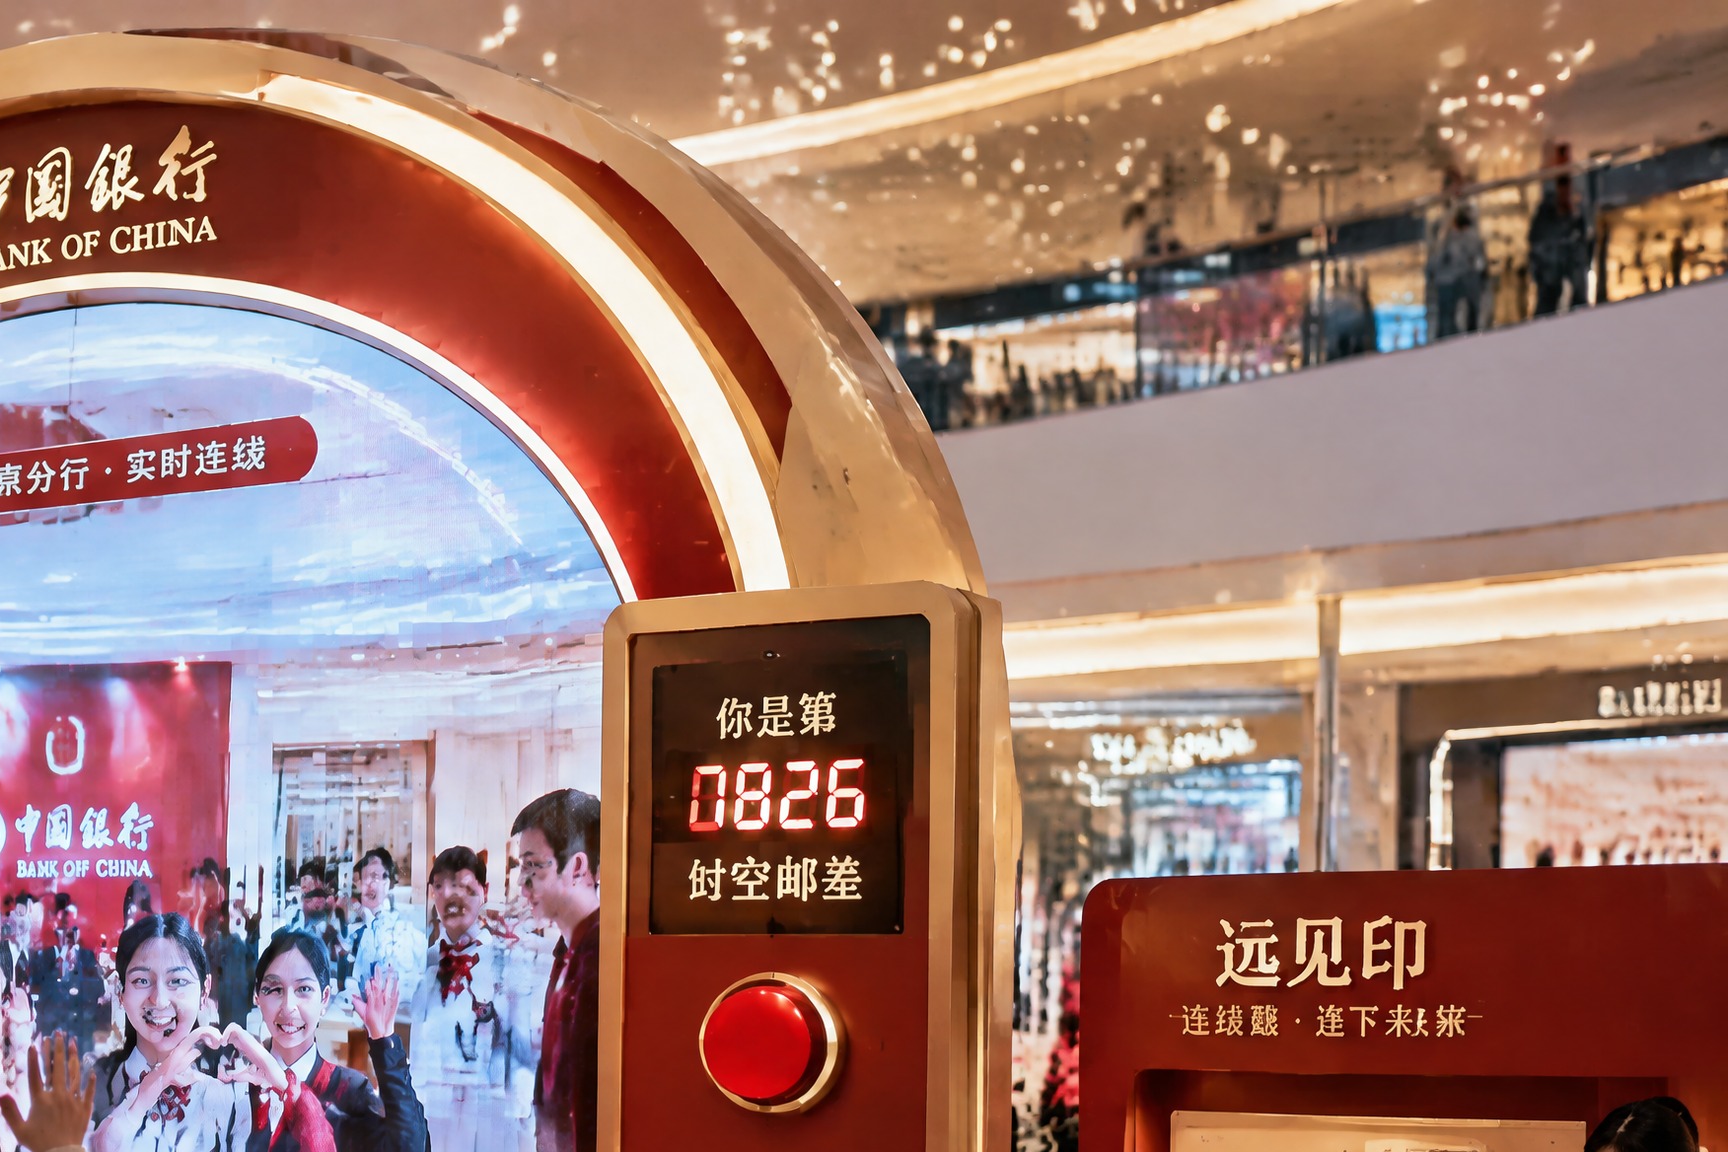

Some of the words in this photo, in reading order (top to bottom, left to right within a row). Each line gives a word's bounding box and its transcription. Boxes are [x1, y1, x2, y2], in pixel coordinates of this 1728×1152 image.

[61, 230, 100, 260] OF
[110, 216, 217, 254] CHINA
[716, 691, 837, 740] 你是第
[689, 758, 865, 831] 0826
[17, 860, 59, 878] BANK
[688, 855, 863, 902] 时空邮差
[1216, 915, 1427, 990] 远见印
